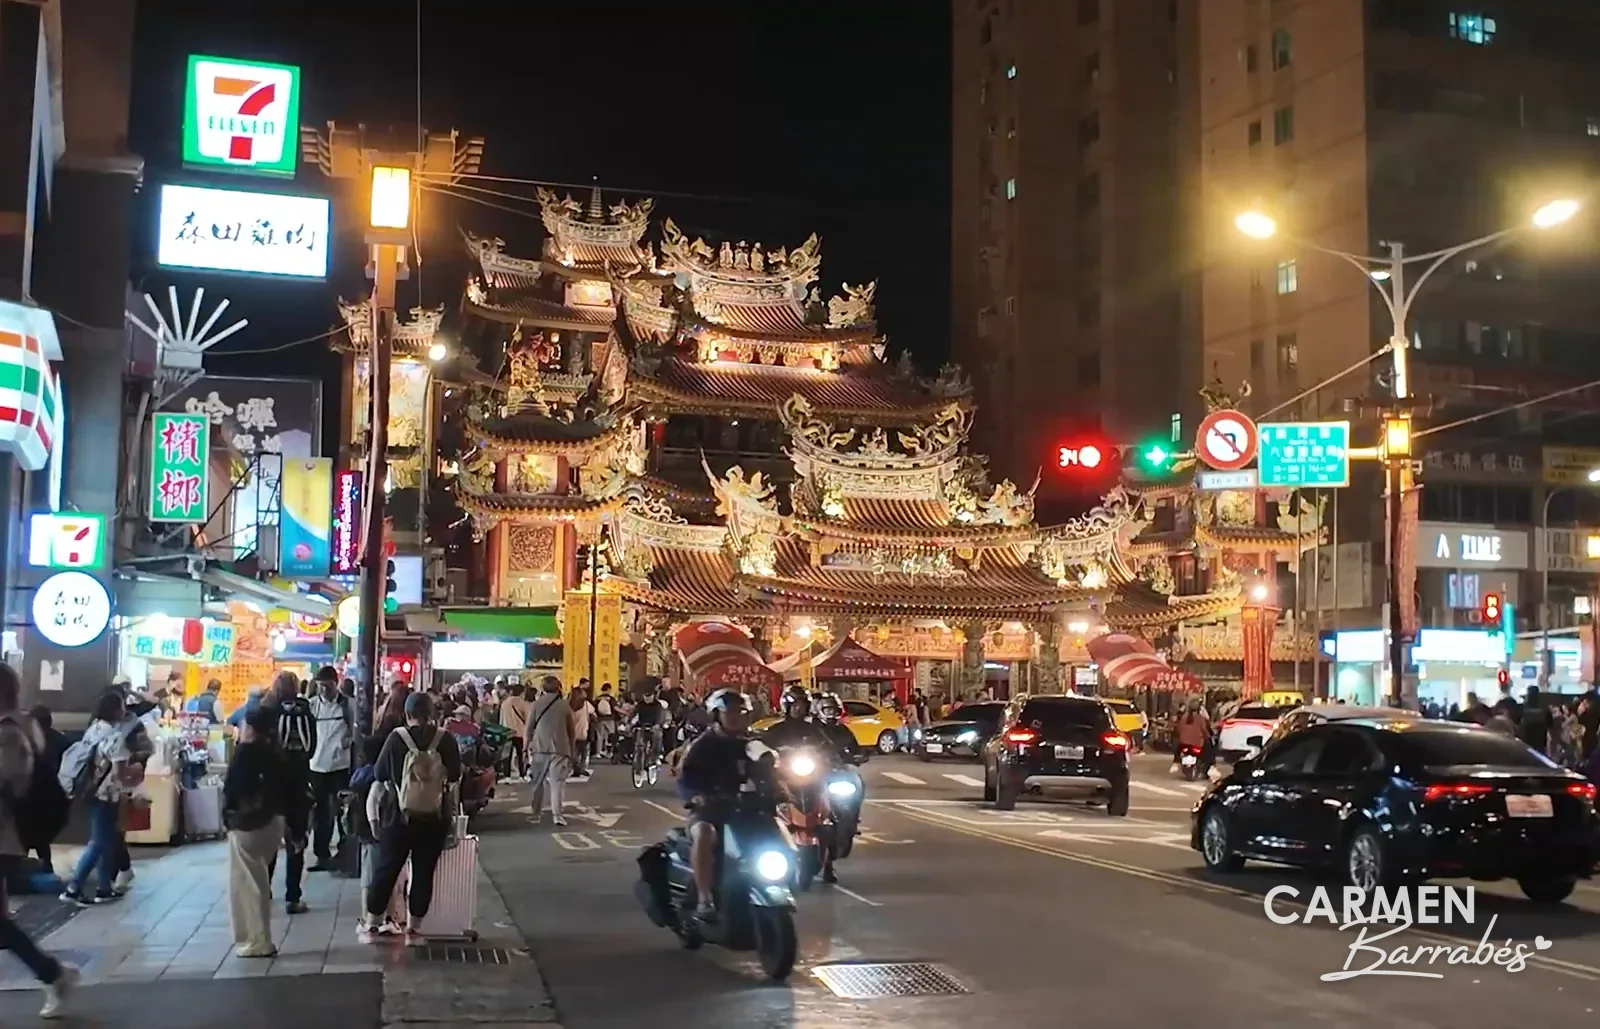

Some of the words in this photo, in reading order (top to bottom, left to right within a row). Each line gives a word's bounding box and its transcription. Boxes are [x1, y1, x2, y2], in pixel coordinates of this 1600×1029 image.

[213, 75, 276, 160] 7
[157, 418, 204, 516] 檳榔
[1459, 533, 1502, 561] TIME
